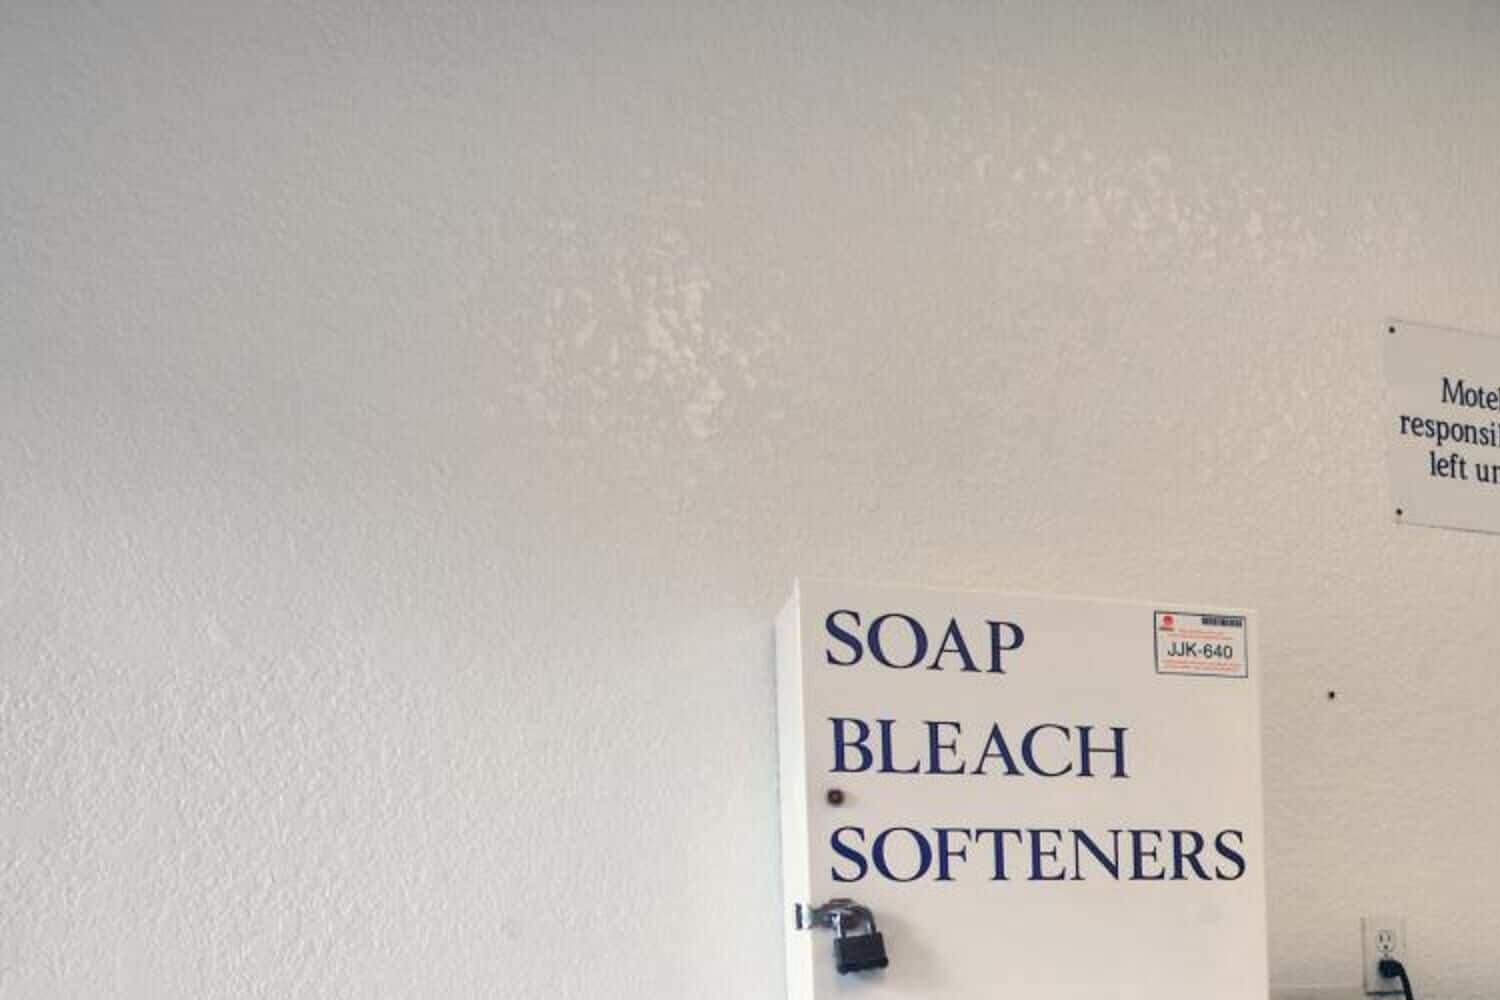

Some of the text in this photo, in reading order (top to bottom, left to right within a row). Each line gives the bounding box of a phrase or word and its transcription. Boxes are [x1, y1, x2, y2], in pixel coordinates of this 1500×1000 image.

[1430, 451, 1468, 480] left
[825, 609, 1024, 674] SOAP
[1167, 641, 1233, 660] JJK-640
[828, 717, 1131, 779] BLEACH
[830, 826, 1246, 883] SOFTENERS
